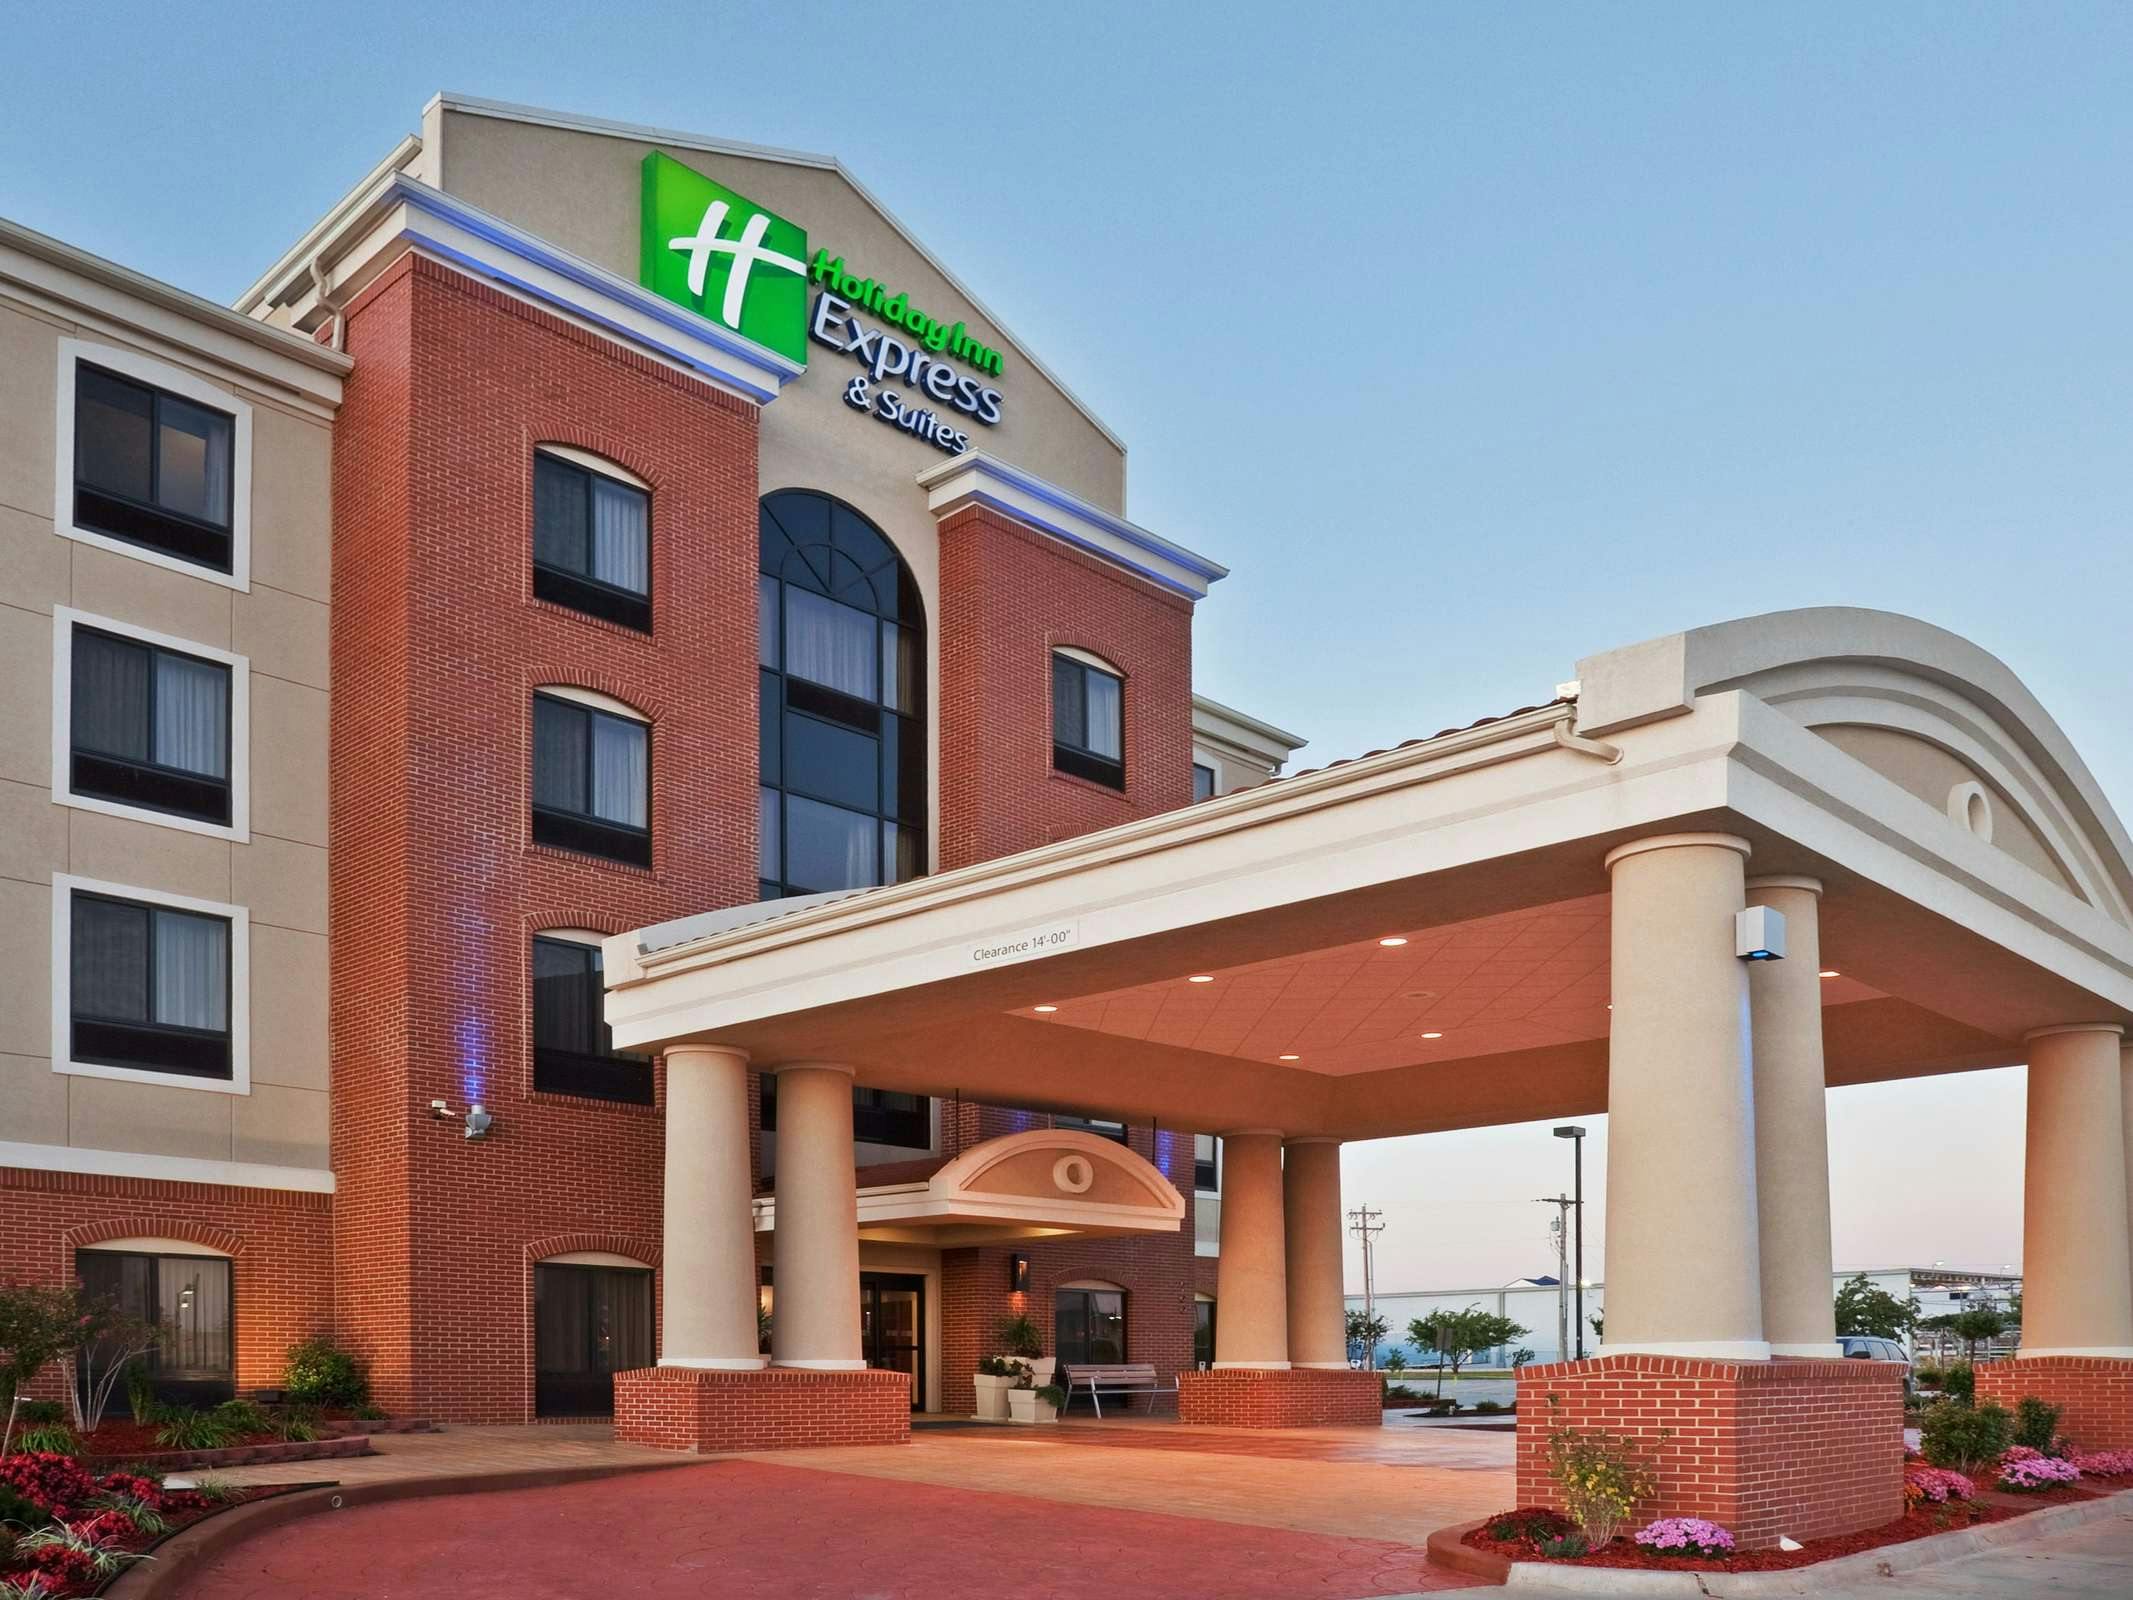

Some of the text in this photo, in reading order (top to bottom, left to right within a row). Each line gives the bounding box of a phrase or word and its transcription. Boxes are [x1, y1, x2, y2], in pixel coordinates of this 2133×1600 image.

[668, 200, 807, 330] H
[810, 247, 1004, 378] Holiday Inn
[809, 291, 1004, 424] Express
[843, 376, 969, 455] & Suites
[973, 941, 1029, 961] Clearance
